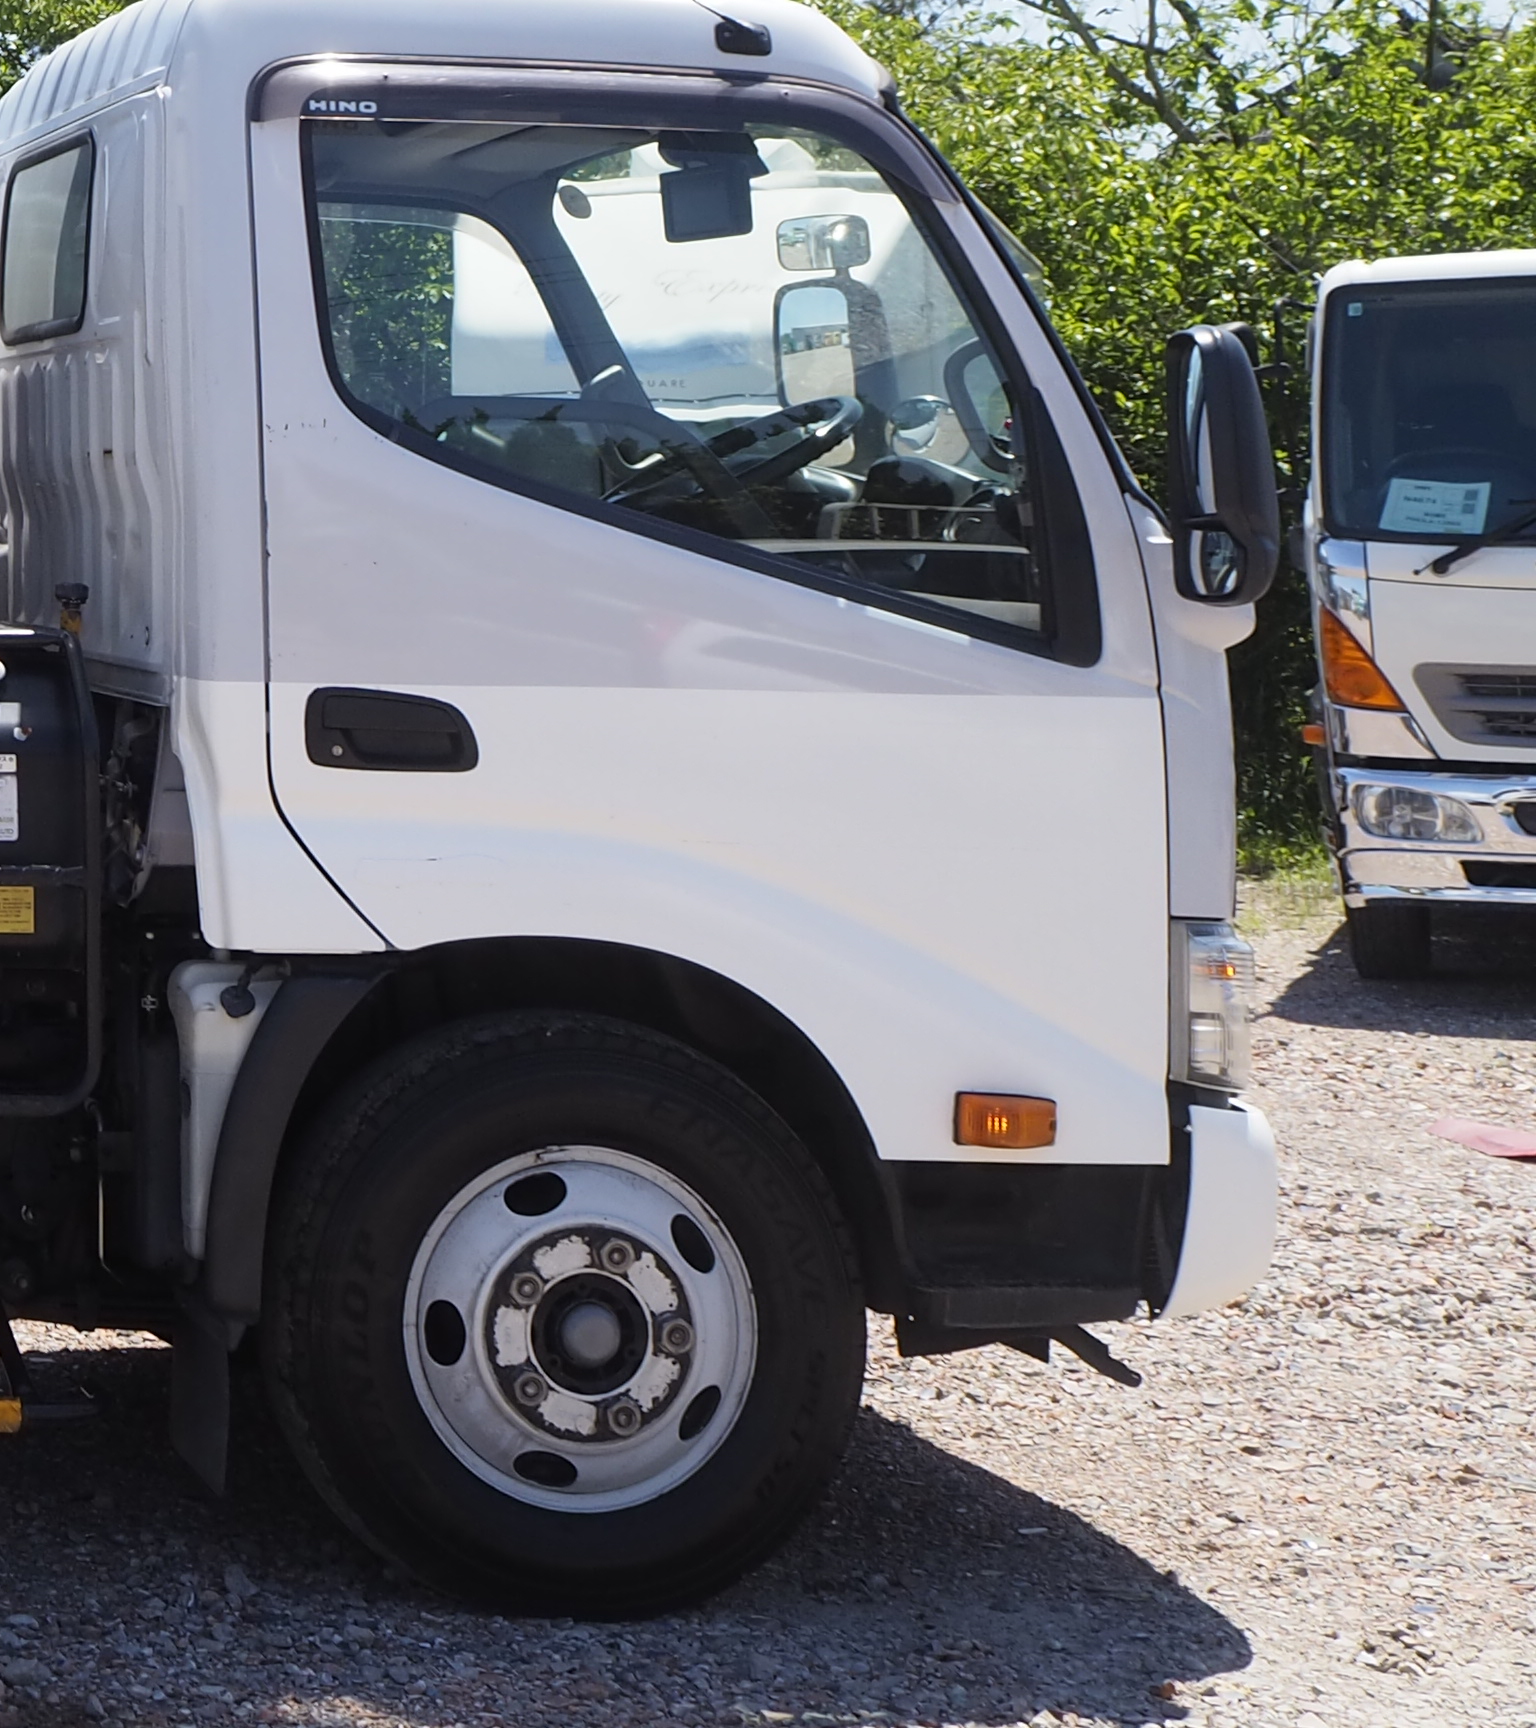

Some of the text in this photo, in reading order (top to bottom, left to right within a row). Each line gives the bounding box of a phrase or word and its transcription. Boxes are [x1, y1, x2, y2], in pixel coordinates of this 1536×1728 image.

[308, 99, 378, 113] HINO
[644, 1094, 830, 1322] ENASAVE
[339, 1228, 398, 1454] DUNLOP
